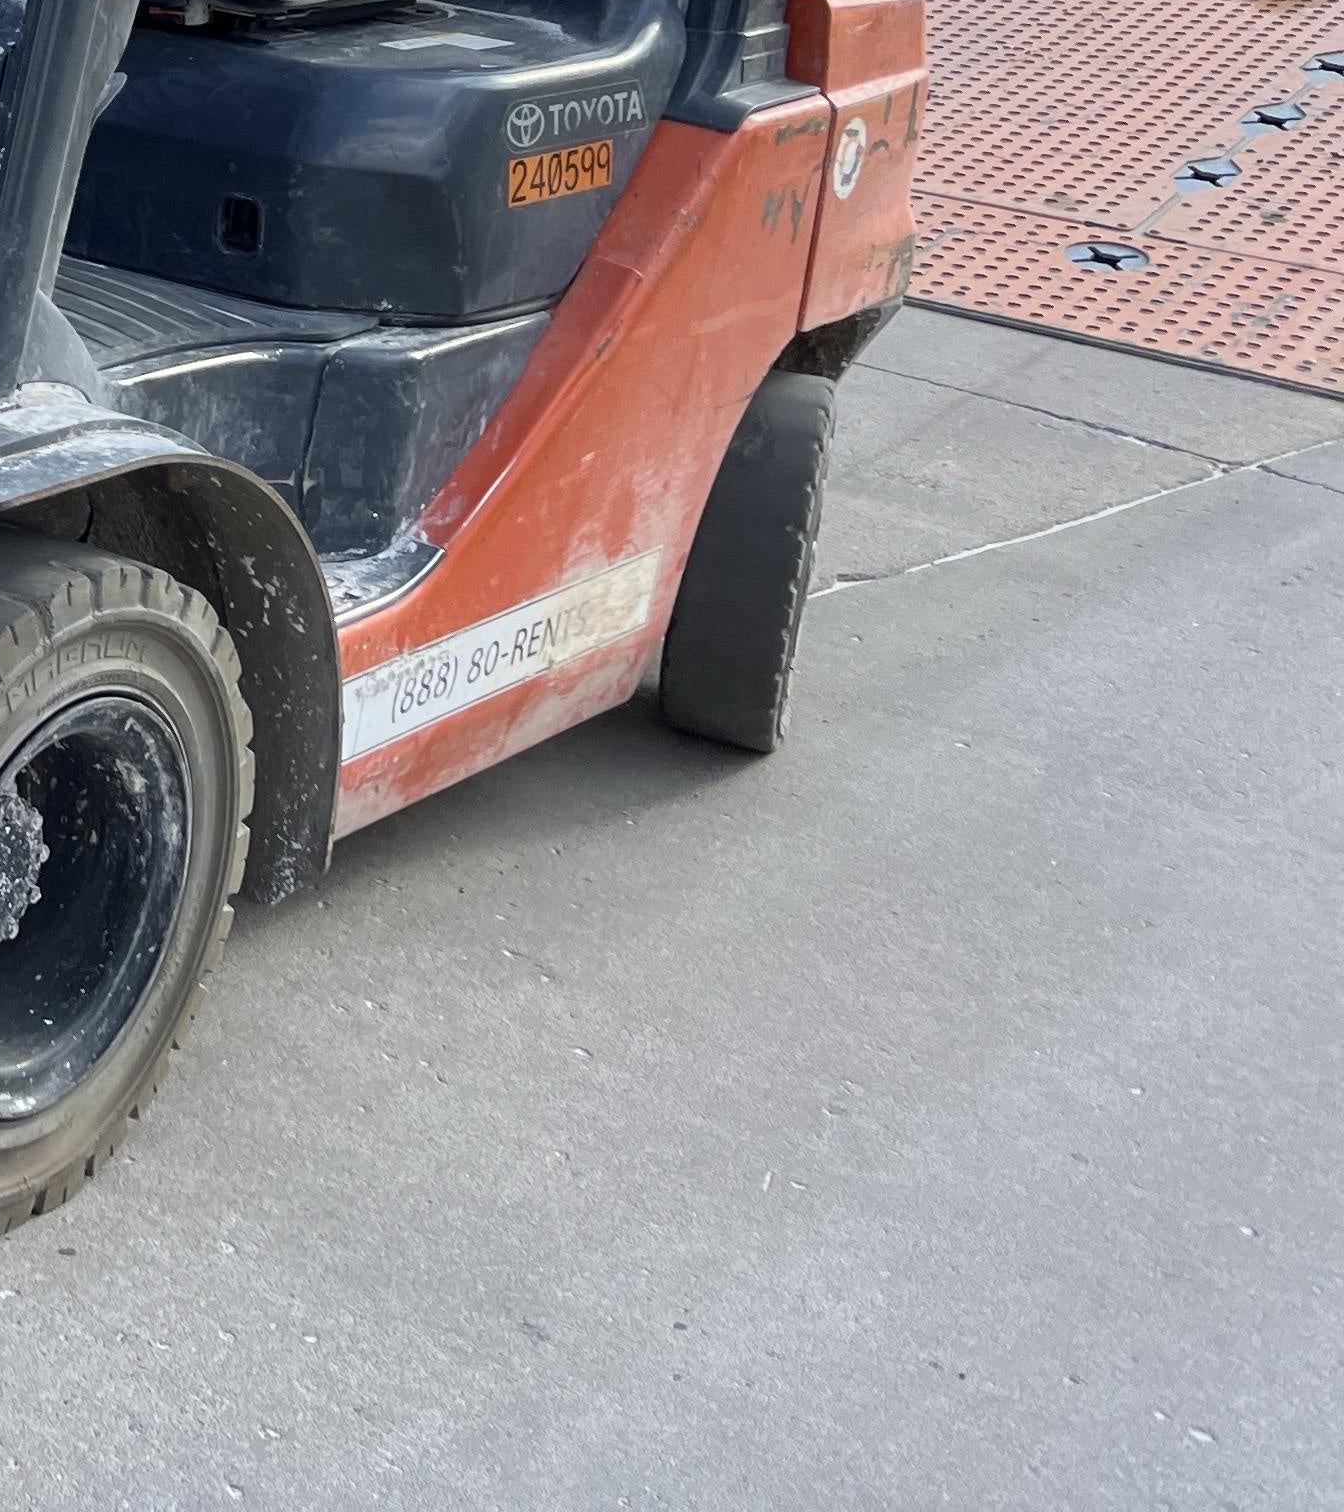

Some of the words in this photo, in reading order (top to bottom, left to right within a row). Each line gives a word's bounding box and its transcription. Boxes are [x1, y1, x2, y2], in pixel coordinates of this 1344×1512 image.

[547, 90, 645, 137] TOYOTA
[511, 143, 612, 204] 240599
[391, 655, 458, 724] (888)
